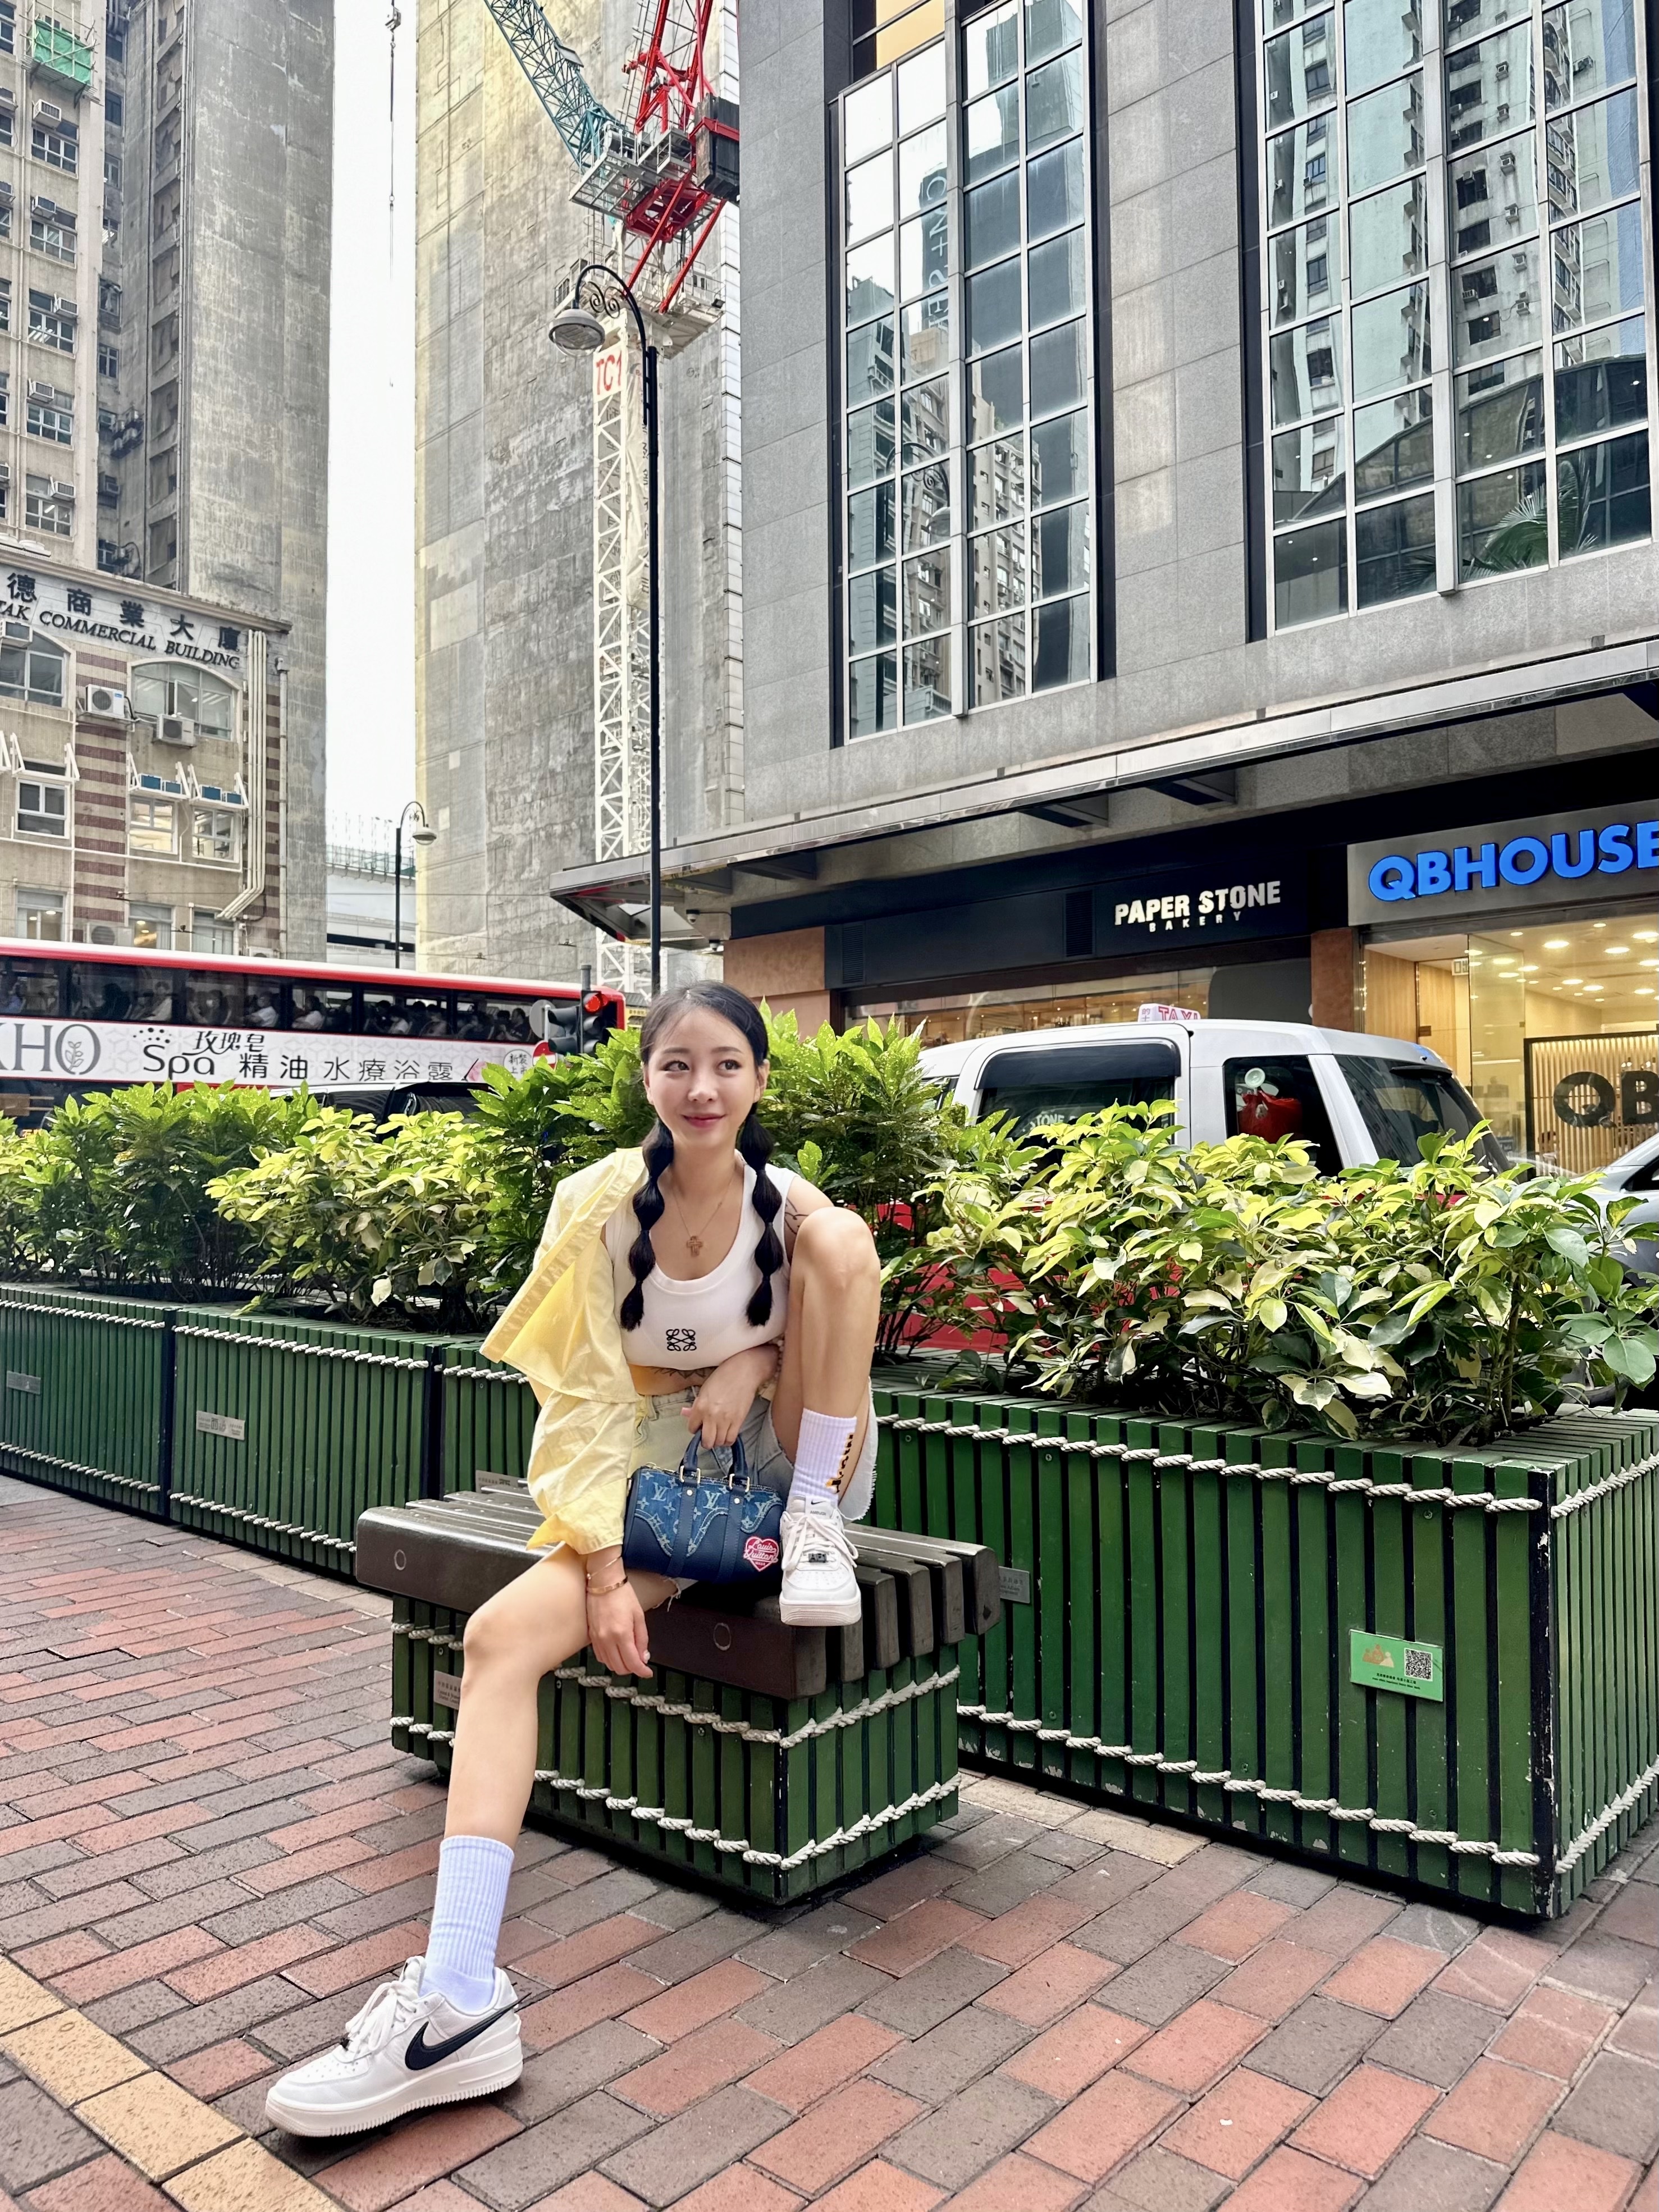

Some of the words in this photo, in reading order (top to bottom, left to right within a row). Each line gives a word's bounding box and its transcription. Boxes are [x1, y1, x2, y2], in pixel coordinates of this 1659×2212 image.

[596, 350, 623, 396] TC1
[39, 611, 156, 651] COMMERCIAL
[164, 640, 240, 669] BUILDING
[1114, 894, 1190, 926] PAPER
[1198, 880, 1281, 914] STONE
[1149, 911, 1241, 933] BAKERY
[0, 1022, 101, 1075] HO
[143, 1044, 215, 1080] Spa
[748, 1540, 776, 1553] Louis
